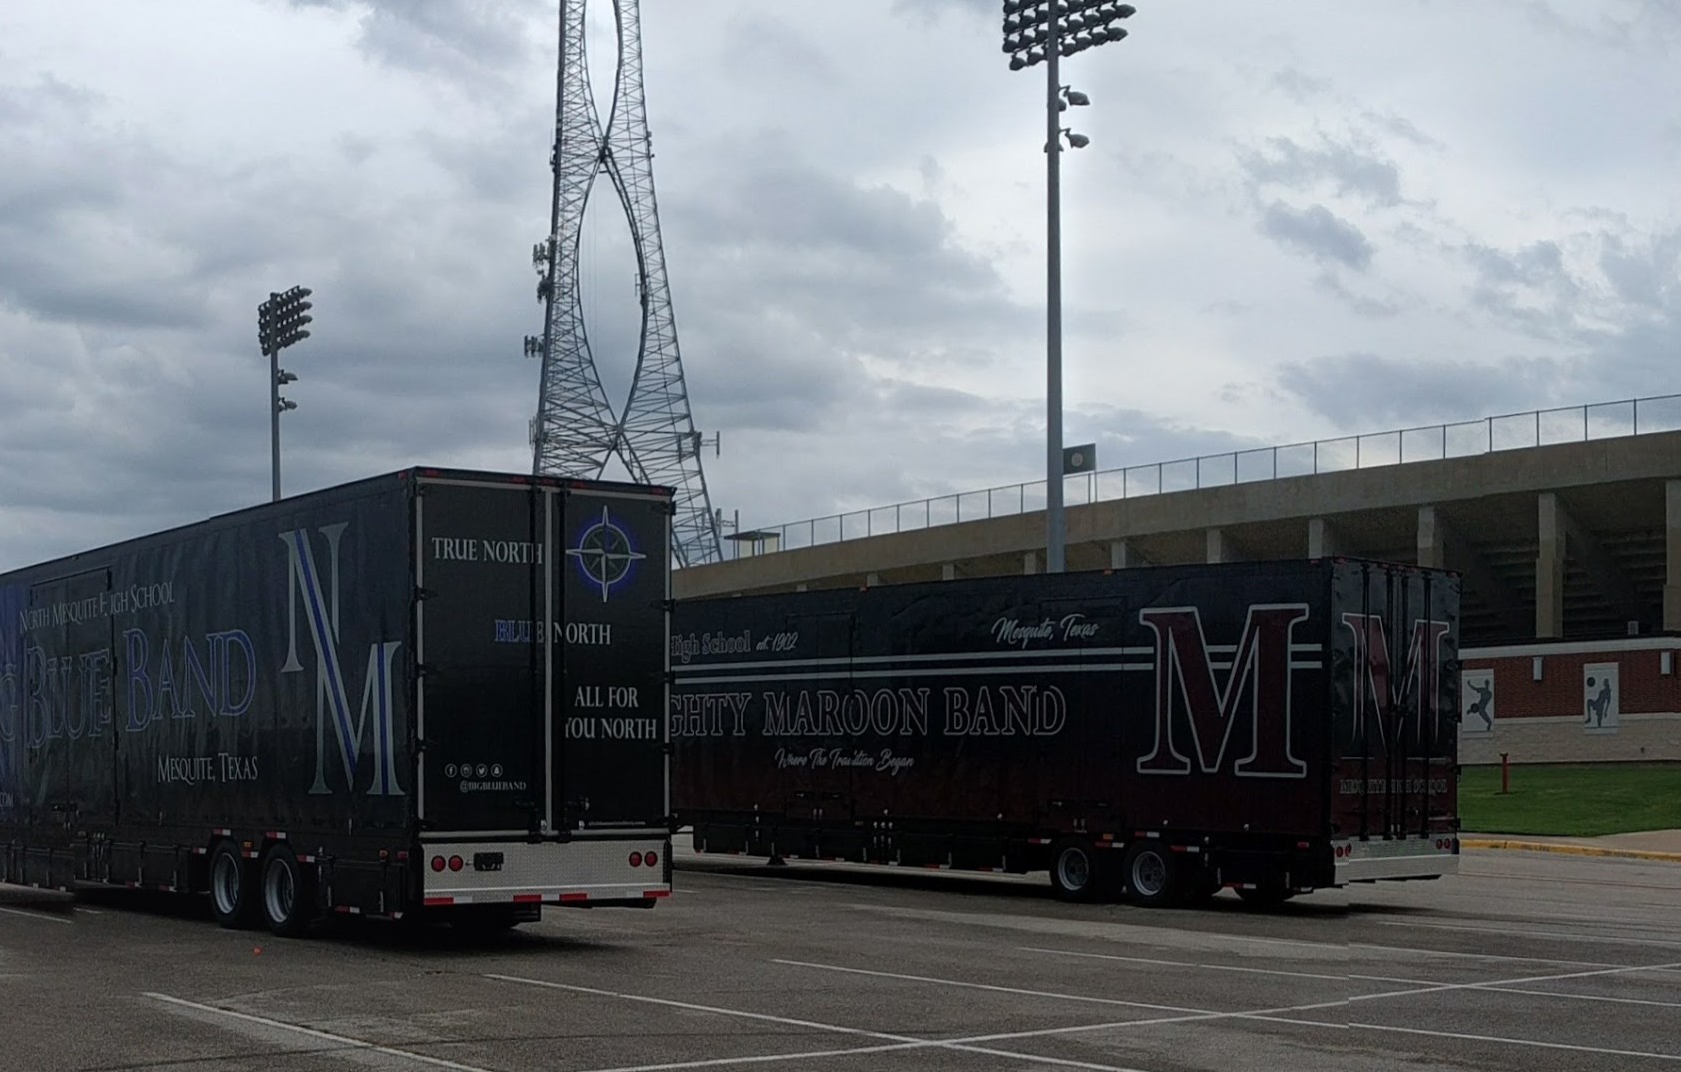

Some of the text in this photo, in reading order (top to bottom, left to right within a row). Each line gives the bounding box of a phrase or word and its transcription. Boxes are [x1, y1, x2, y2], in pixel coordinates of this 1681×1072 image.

[432, 537, 544, 564] TRUE NORTH
[19, 607, 50, 634] NORTH
[52, 597, 98, 627] MESQUITE
[130, 581, 175, 614] SCHOOL
[553, 622, 612, 645] NORTH
[702, 629, 752, 655] School
[771, 631, 799, 651] 1902
[1060, 613, 1100, 642] Texas
[26, 646, 112, 749] BLUE
[123, 628, 256, 732] BAND
[574, 686, 639, 708] ALL FOR
[1136, 602, 1310, 779] M
[762, 687, 930, 737] MAROON
[943, 685, 1067, 736] BAND
[565, 717, 657, 740] YOU NORTH
[158, 753, 259, 785] MESQUITE, TEXAS
[775, 747, 808, 769] Where
[808, 748, 828, 770] The
[875, 747, 916, 777] Began
